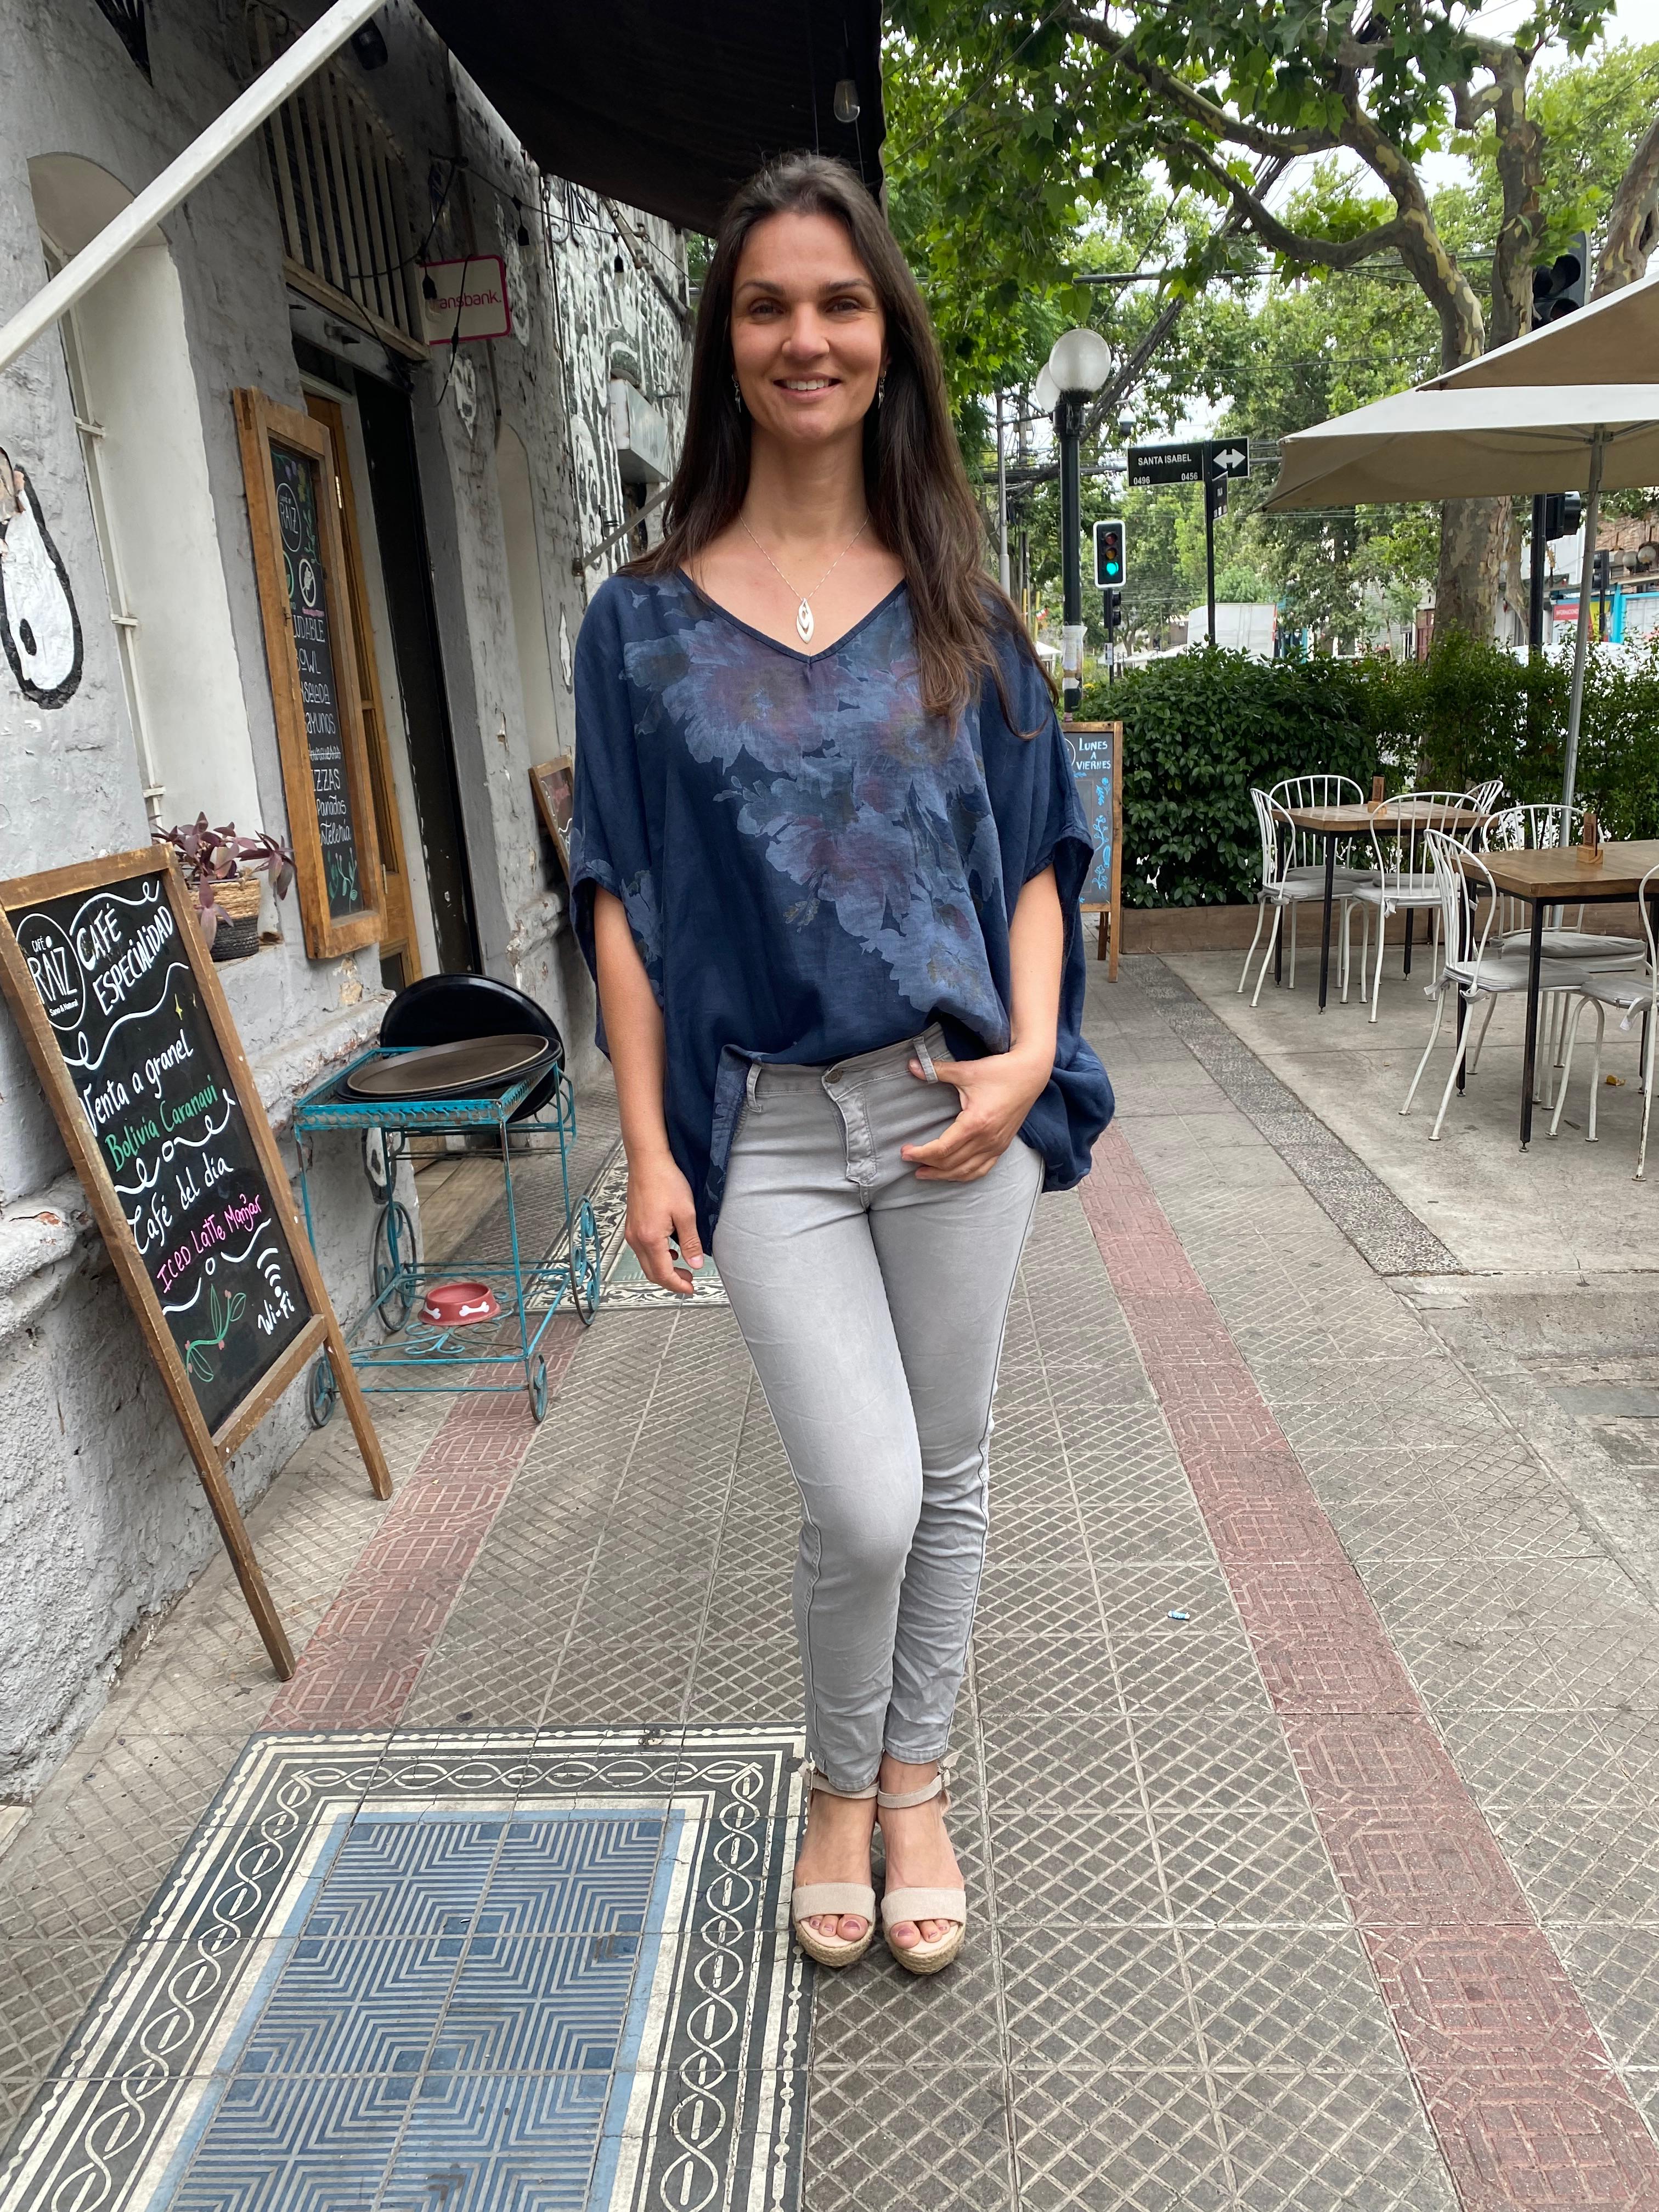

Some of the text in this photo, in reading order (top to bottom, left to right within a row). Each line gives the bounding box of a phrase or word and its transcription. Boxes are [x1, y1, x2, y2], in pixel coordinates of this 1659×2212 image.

[430, 290, 502, 310] ansbank.
[1138, 454, 1192, 466] SANTA ISABEL
[1133, 472, 1198, 485] 0496 0456
[1079, 737, 1108, 751] LUNES
[1076, 760, 1111, 770] VIERNES
[1090, 751, 1097, 760] A
[31, 935, 47, 953] CAFÉ
[76, 902, 121, 971] CAFÉ
[78, 1028, 194, 1137] Venta a granel
[104, 1074, 218, 1172] Bolivia Caranavi
[126, 1192, 172, 1255] Café
[176, 1166, 200, 1210] del
[257, 1290, 295, 1335] Wi-Fi
